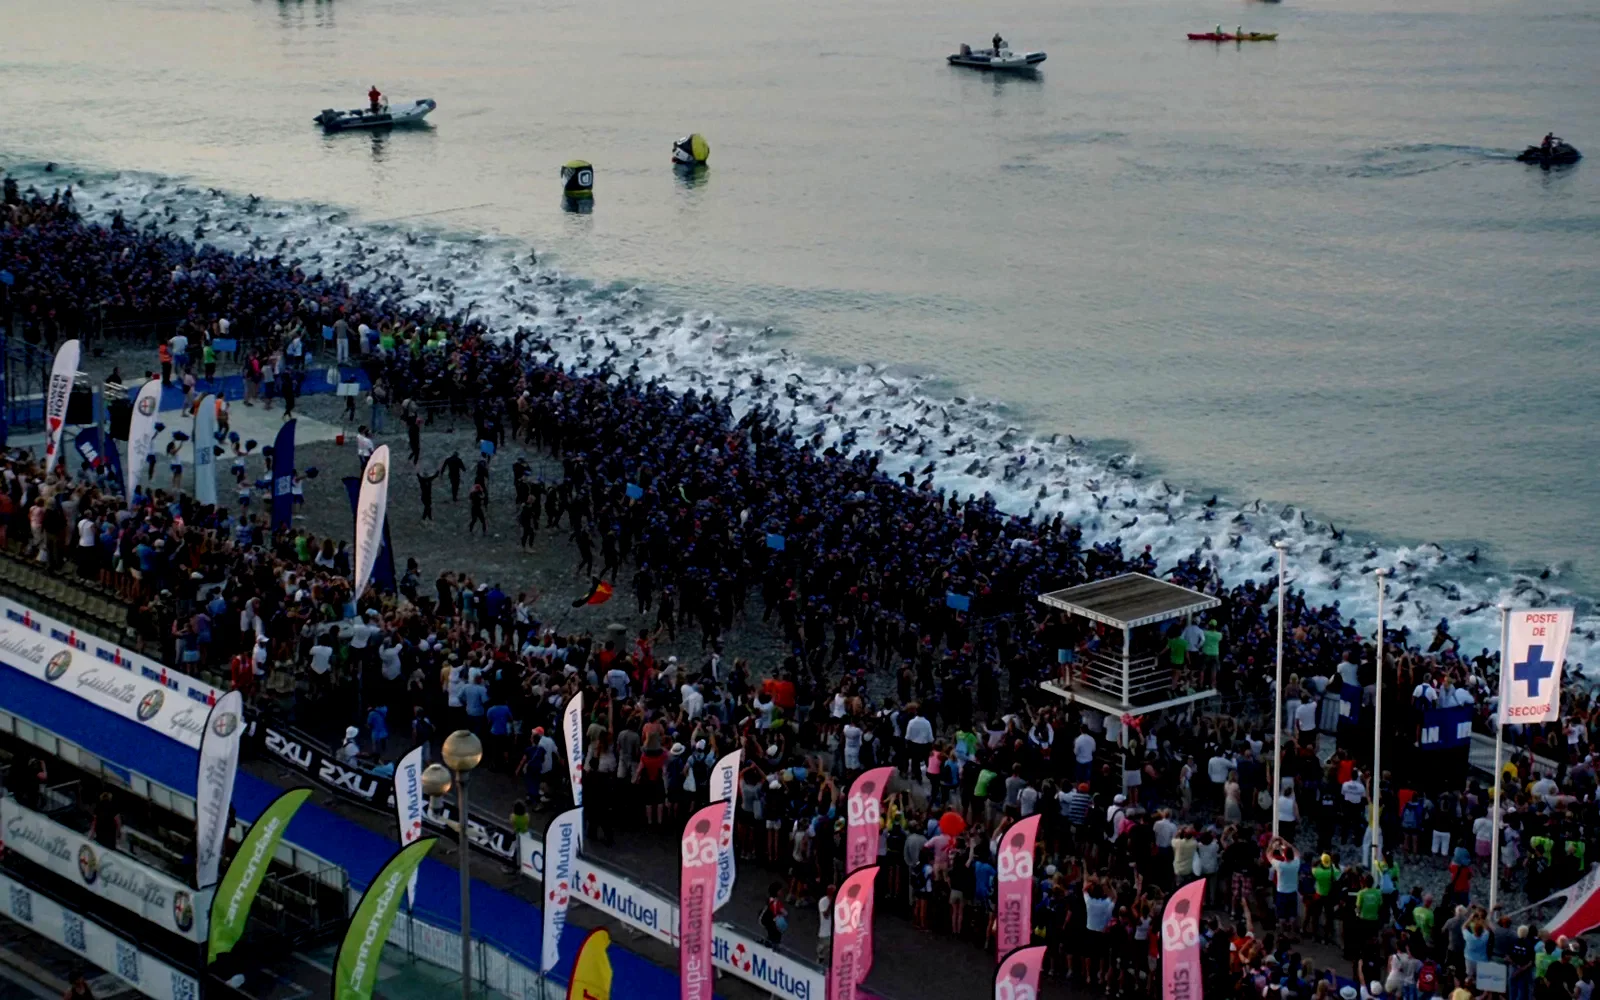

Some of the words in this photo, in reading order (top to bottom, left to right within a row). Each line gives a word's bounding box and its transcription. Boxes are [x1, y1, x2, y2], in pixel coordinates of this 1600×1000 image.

[53, 375, 68, 417] HORSE
[1526, 613, 1558, 624] POSTE
[1532, 627, 1546, 637] DE
[1508, 703, 1552, 717] SECOURS
[570, 708, 583, 763] Mutuel
[265, 727, 313, 768] 2XU
[318, 758, 379, 798] 2XU
[404, 763, 421, 821] Mutuel
[847, 792, 881, 827] ga
[223, 815, 282, 929] cannondale
[557, 822, 573, 879] Mutuel
[681, 832, 718, 869] ga
[997, 845, 1034, 882] ga
[602, 882, 658, 931] Mutuel
[349, 871, 405, 993] cannondale
[1161, 911, 1200, 952] ga
[752, 953, 810, 1000] Mutuel
